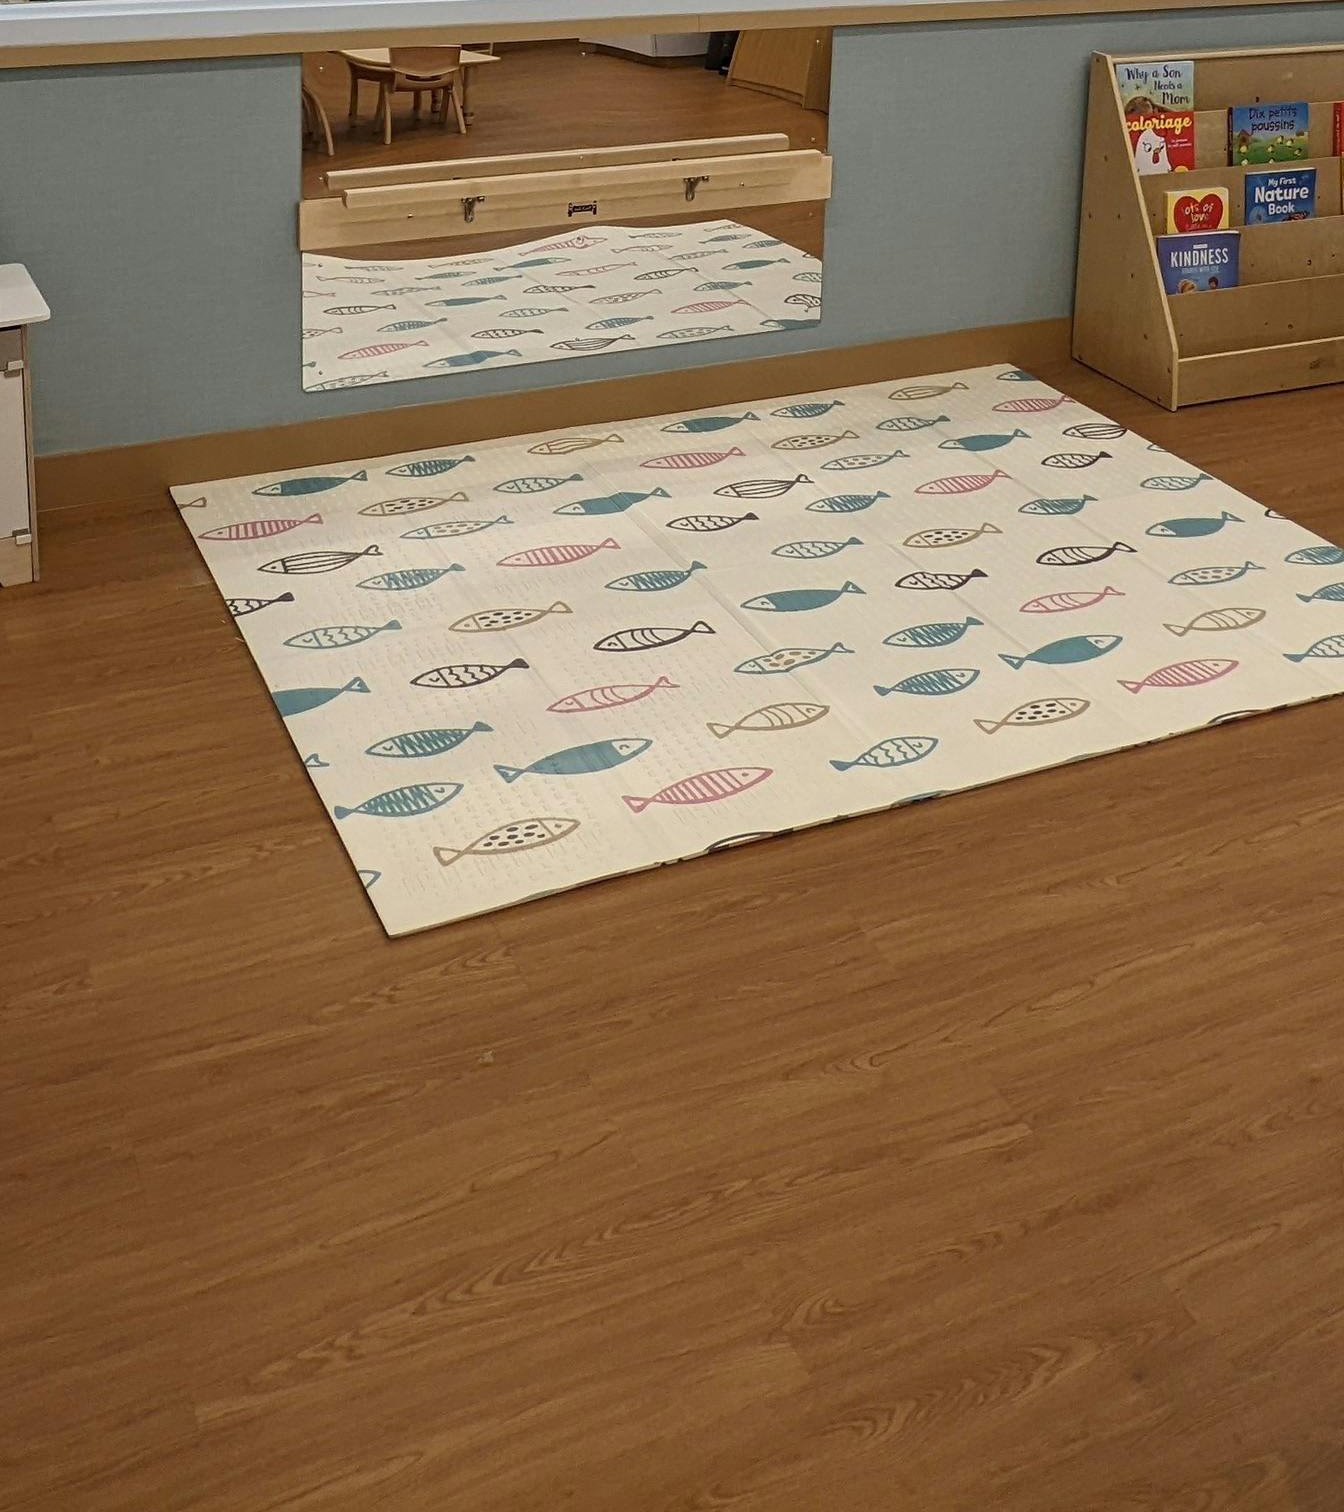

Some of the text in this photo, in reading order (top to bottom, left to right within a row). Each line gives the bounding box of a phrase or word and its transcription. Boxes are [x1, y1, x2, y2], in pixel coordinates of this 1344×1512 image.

[1126, 64, 1182, 84] Why a Son
[1162, 91, 1190, 105] Mom
[1248, 105, 1298, 121] Dix petits
[1126, 114, 1193, 135] coloriage
[1251, 120, 1295, 134] poussins
[1268, 177, 1297, 187] My First
[1255, 186, 1309, 203] Nature
[1268, 202, 1295, 215] Book
[1170, 248, 1229, 267] KINDNESS
